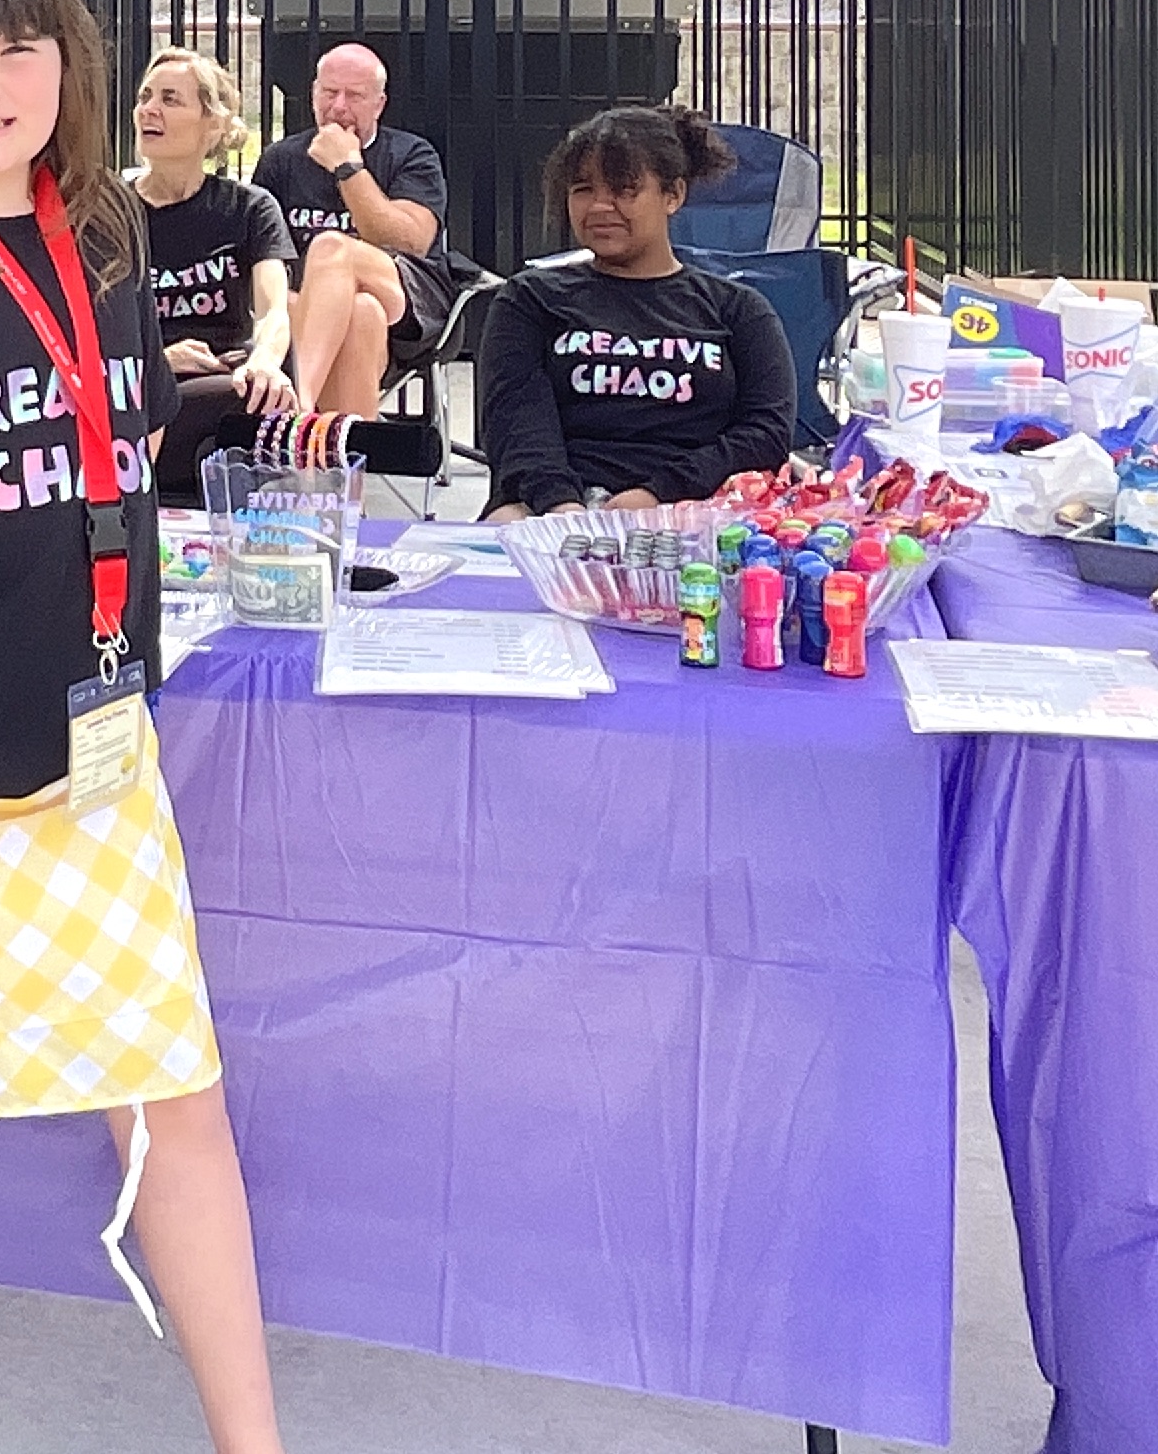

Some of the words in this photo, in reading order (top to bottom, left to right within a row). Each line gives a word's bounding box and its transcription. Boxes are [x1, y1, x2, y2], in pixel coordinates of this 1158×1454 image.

[554, 330, 723, 371] CREATIVE
[1066, 345, 1134, 370] SONIC
[571, 363, 693, 403] CHAOS
